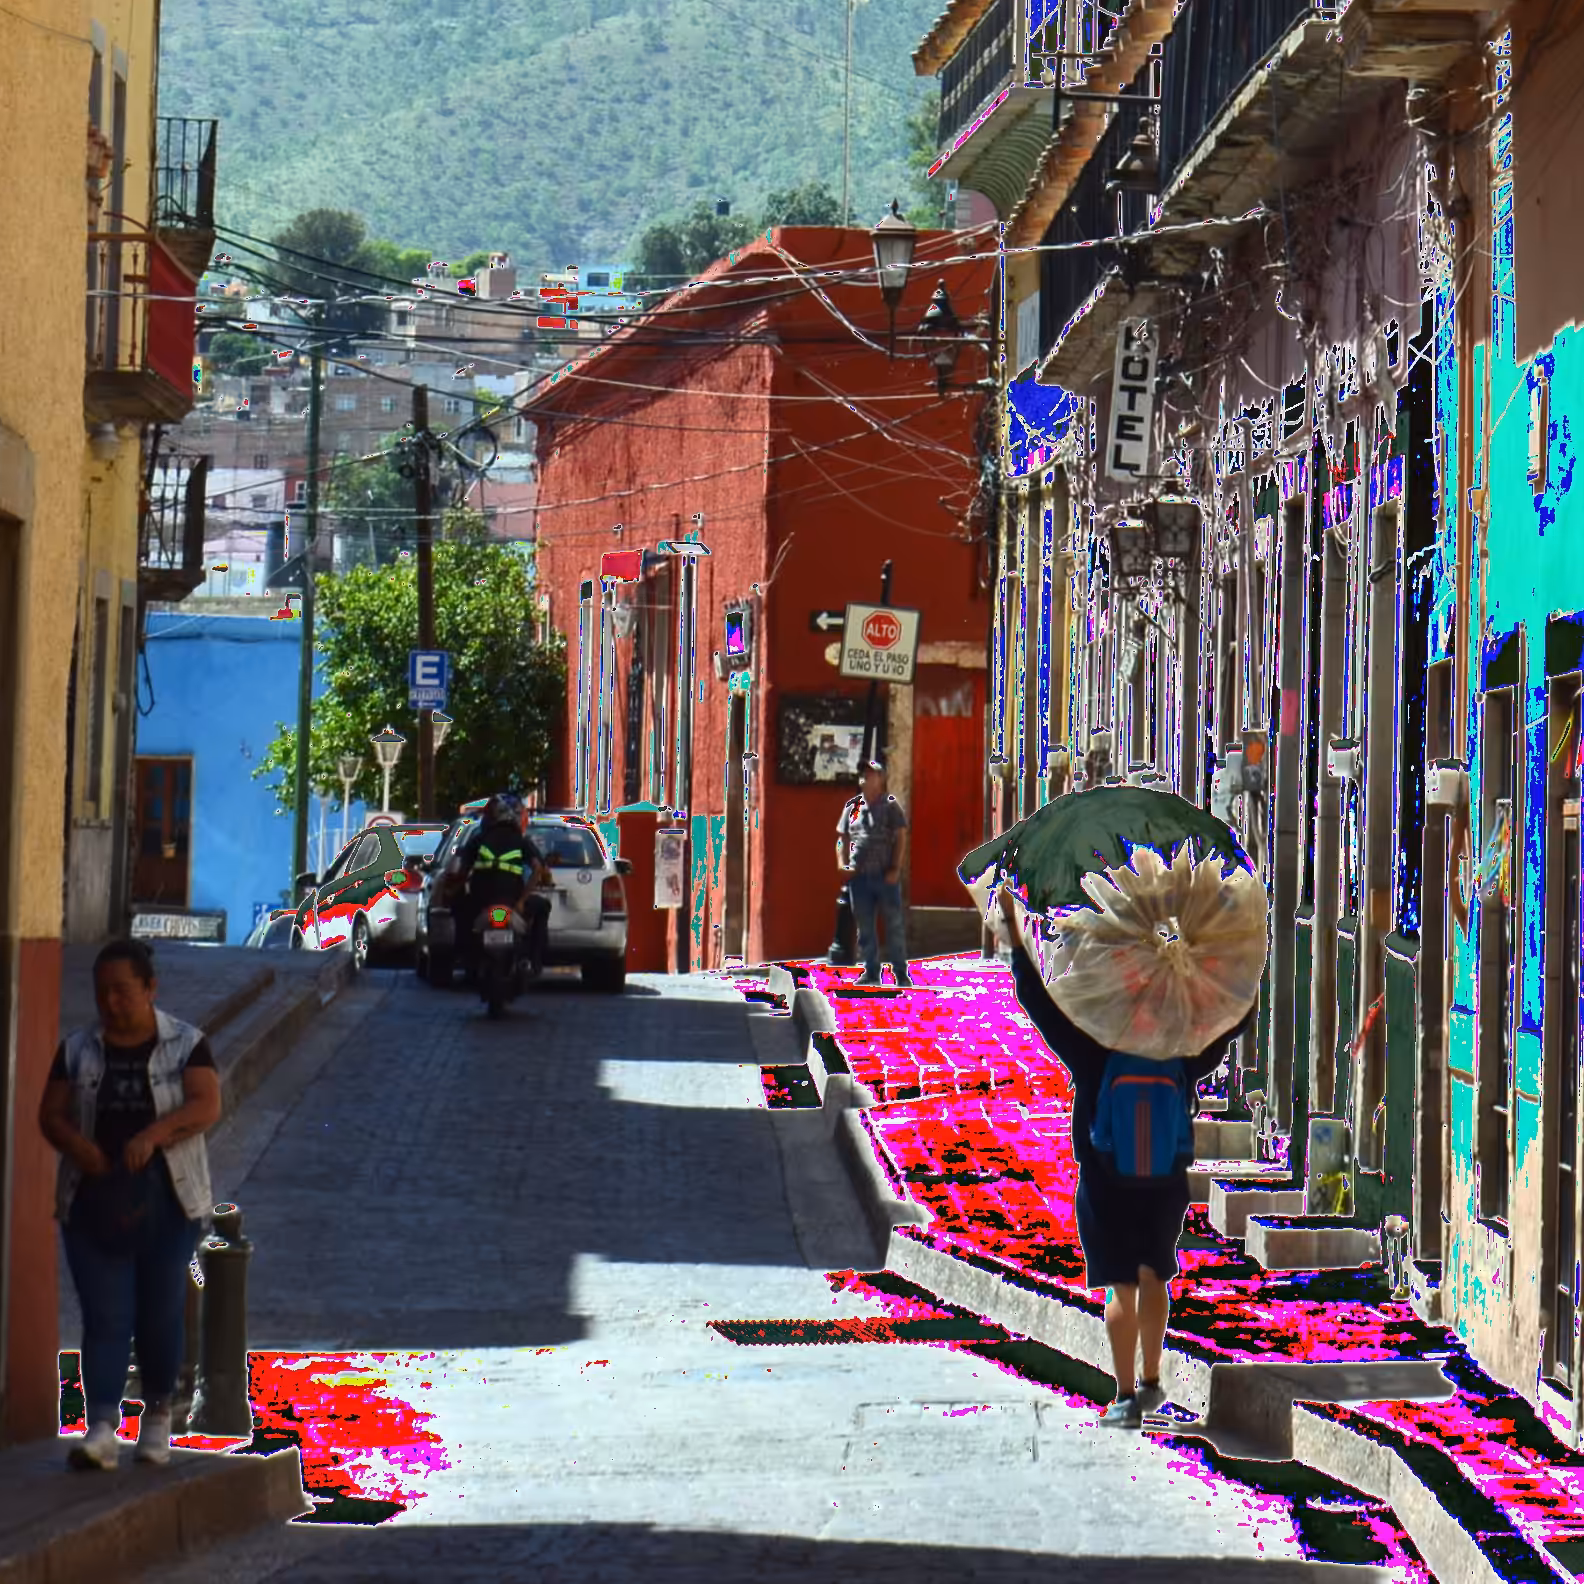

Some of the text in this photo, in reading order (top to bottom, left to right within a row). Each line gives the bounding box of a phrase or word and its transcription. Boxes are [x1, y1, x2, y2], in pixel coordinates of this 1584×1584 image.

[866, 622, 897, 639] ALTO
[847, 648, 910, 665] CEDA EL PASO
[415, 655, 440, 685] E
[849, 660, 871, 672] UNO
[874, 663, 881, 673] Y
